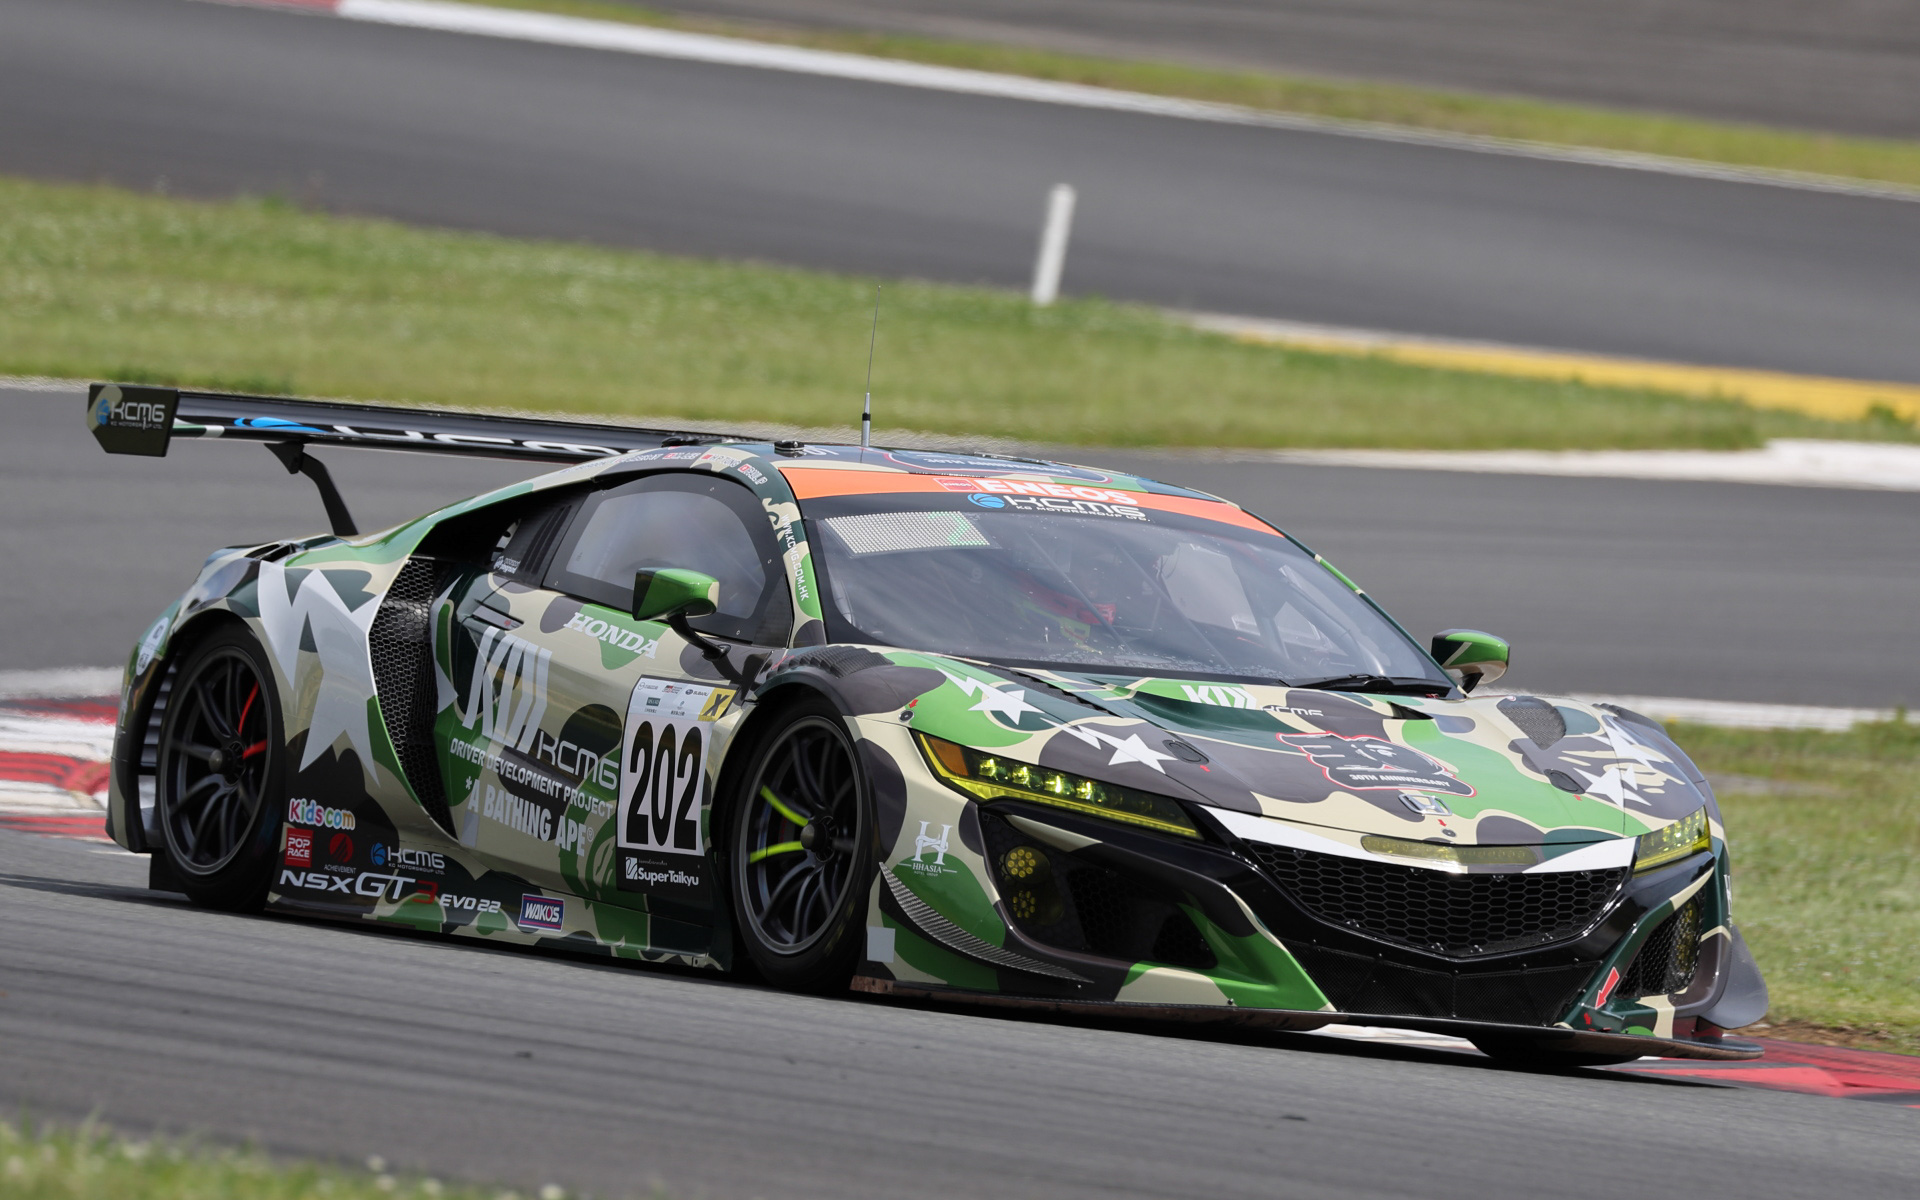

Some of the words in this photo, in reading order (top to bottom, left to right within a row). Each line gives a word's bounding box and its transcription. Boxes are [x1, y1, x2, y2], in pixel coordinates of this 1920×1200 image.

[973, 479, 1138, 505] ENEOS
[1003, 495, 1146, 518] KCMG
[781, 513, 809, 601] WWW.KCMG.COM.HK
[563, 612, 659, 659] HONDA
[703, 693, 730, 717] X
[535, 730, 620, 791] KCMG
[450, 737, 486, 767] DRIVER
[486, 754, 562, 799] DEVELOPMENT
[563, 785, 614, 820] PROJECT
[626, 720, 702, 851] 202
[1379, 775, 1451, 787] ANNIVERSARY
[483, 784, 552, 842] BATHING
[287, 847, 310, 859] RACE
[288, 837, 311, 849] POP
[323, 864, 357, 875] ACHIEVEMENT
[387, 845, 445, 870] KCMG
[912, 862, 942, 874] HHASIA
[440, 894, 476, 909] EVO
[477, 899, 502, 914] 22
